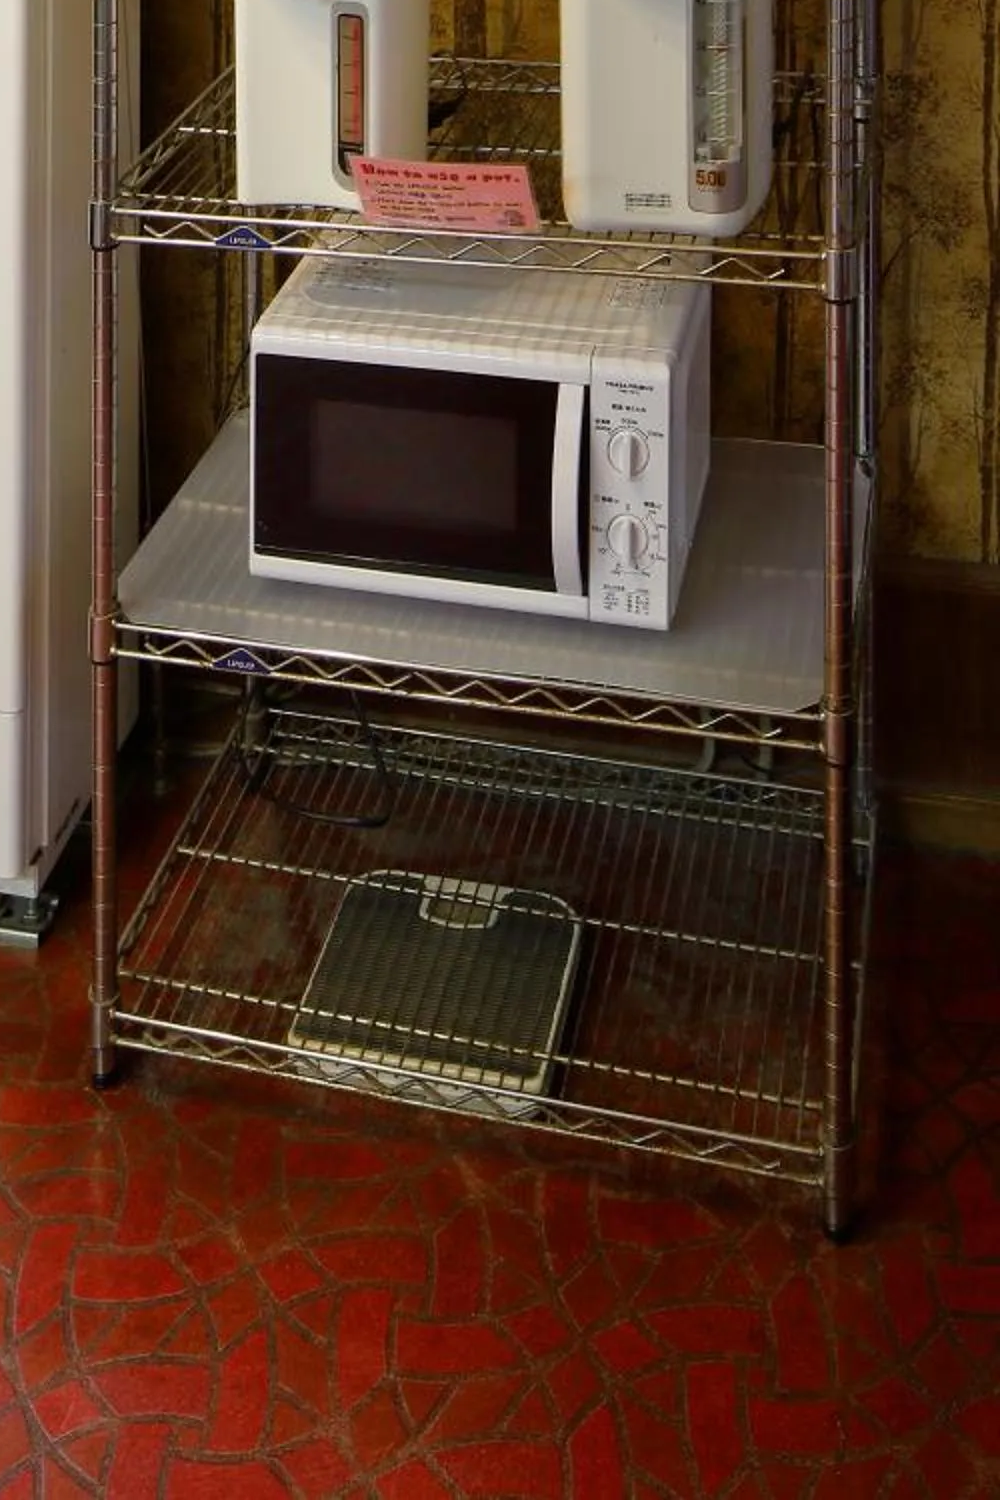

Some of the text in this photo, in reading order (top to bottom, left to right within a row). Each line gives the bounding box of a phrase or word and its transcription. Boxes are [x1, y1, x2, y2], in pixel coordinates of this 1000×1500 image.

[360, 163, 399, 177] How
[404, 169, 423, 179] to
[427, 170, 460, 182] use
